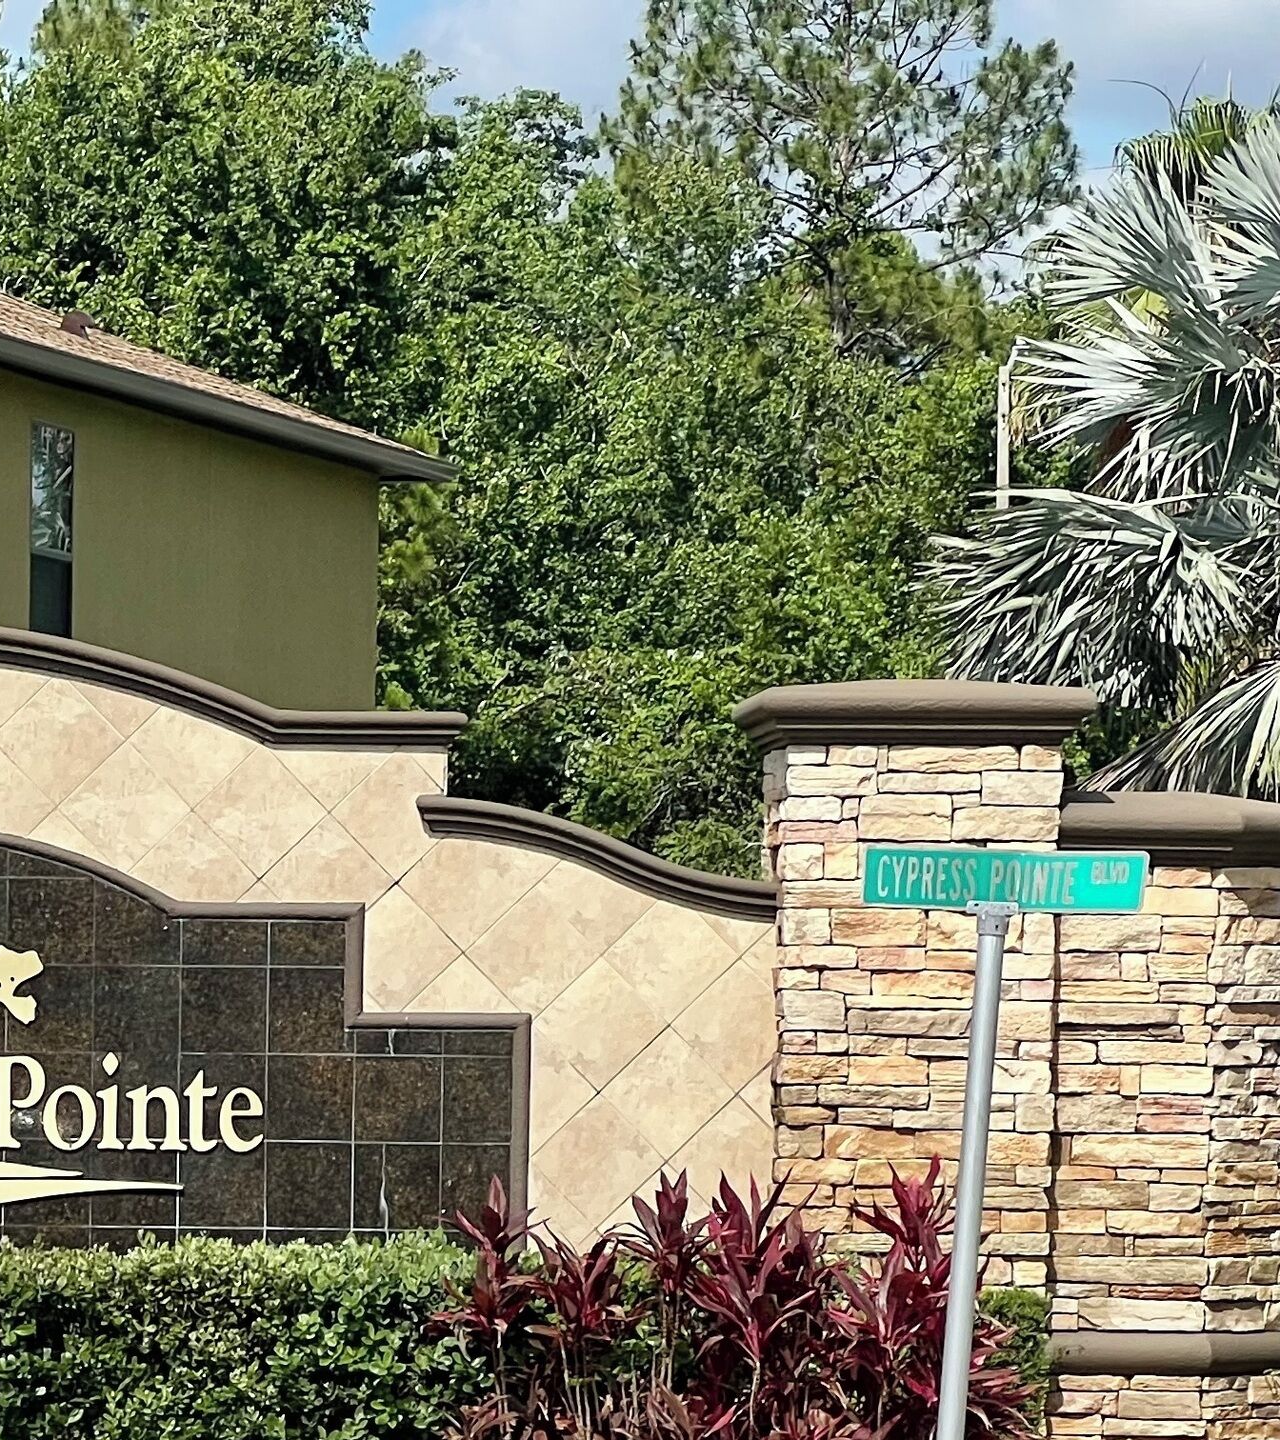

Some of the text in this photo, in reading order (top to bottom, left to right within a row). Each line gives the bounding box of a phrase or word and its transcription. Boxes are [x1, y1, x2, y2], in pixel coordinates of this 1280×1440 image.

[877, 855, 1130, 904] CYPRESS POINTE BLVD
